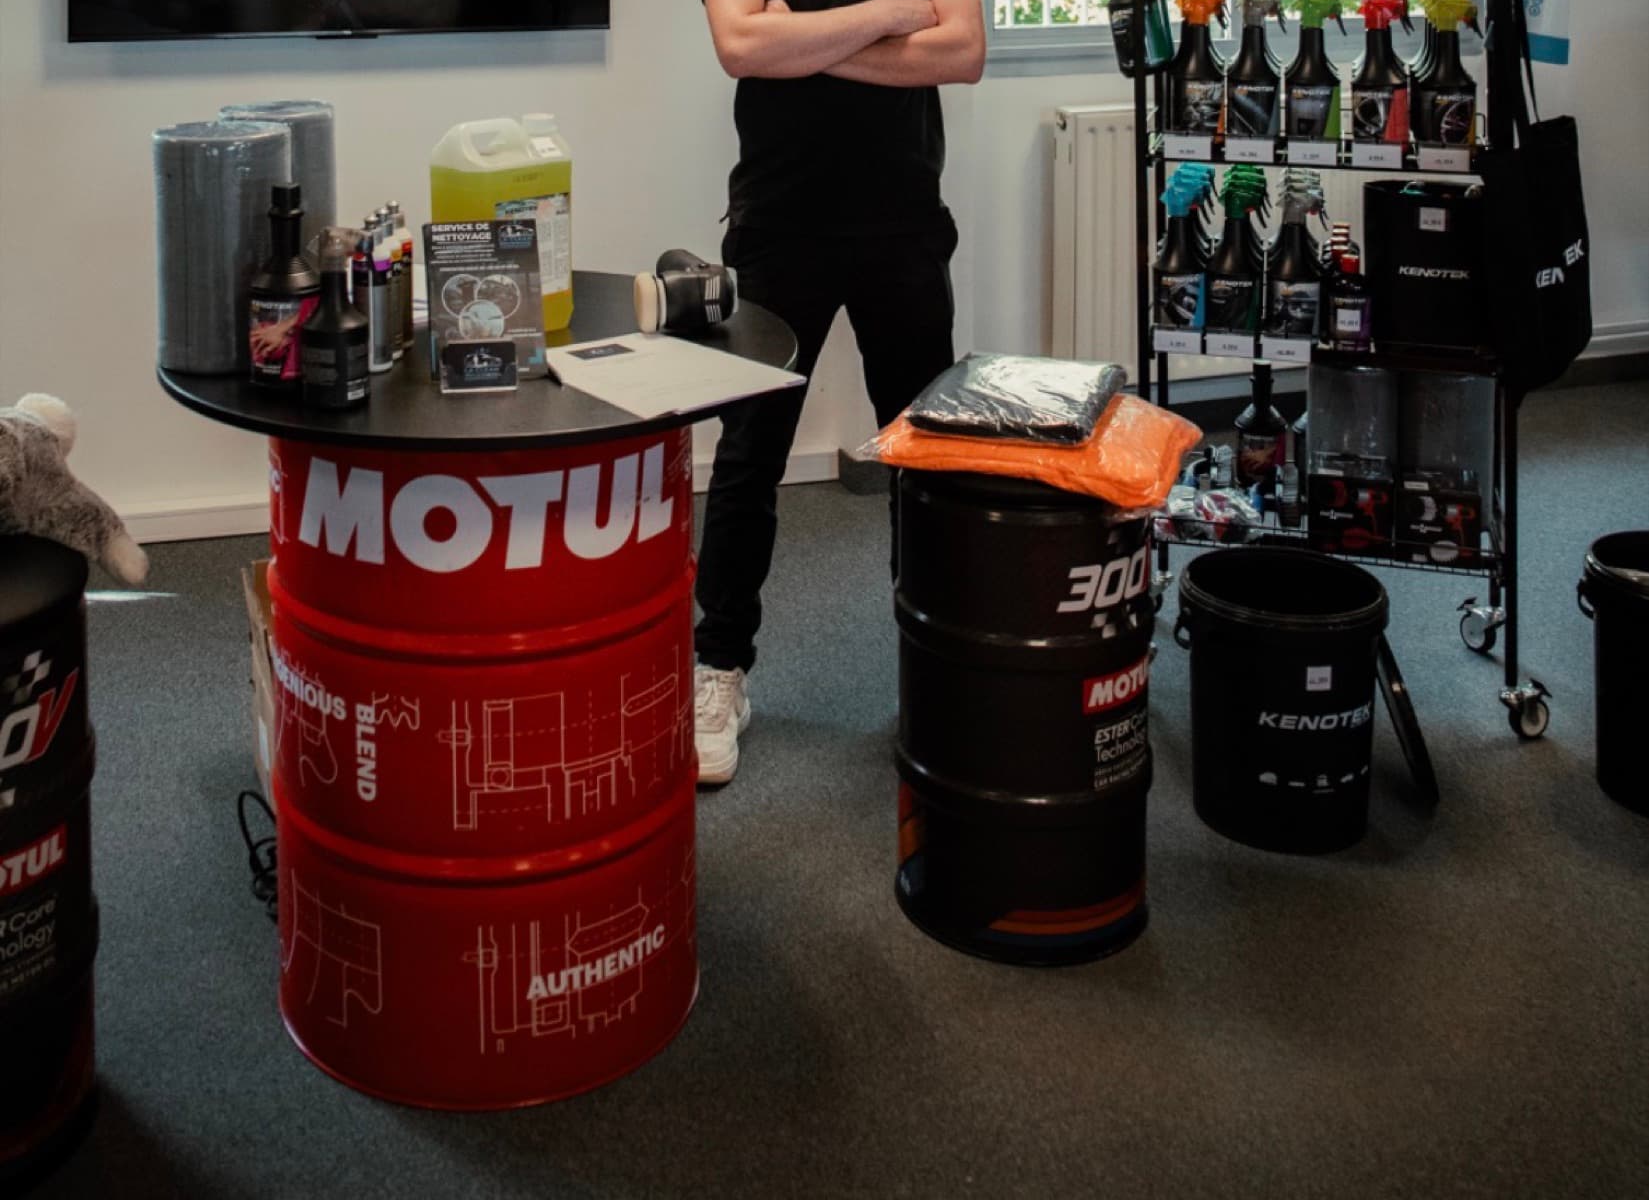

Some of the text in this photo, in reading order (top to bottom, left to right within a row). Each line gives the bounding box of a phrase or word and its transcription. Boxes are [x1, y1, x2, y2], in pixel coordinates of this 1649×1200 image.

[431, 224, 473, 233] SERVICE
[431, 232, 492, 242] NETTOYAGE
[1397, 265, 1471, 280] KENOTEK
[299, 441, 675, 573] MOTUL
[355, 702, 378, 802] BLEND
[526, 921, 666, 1001] AUTHENTIC
